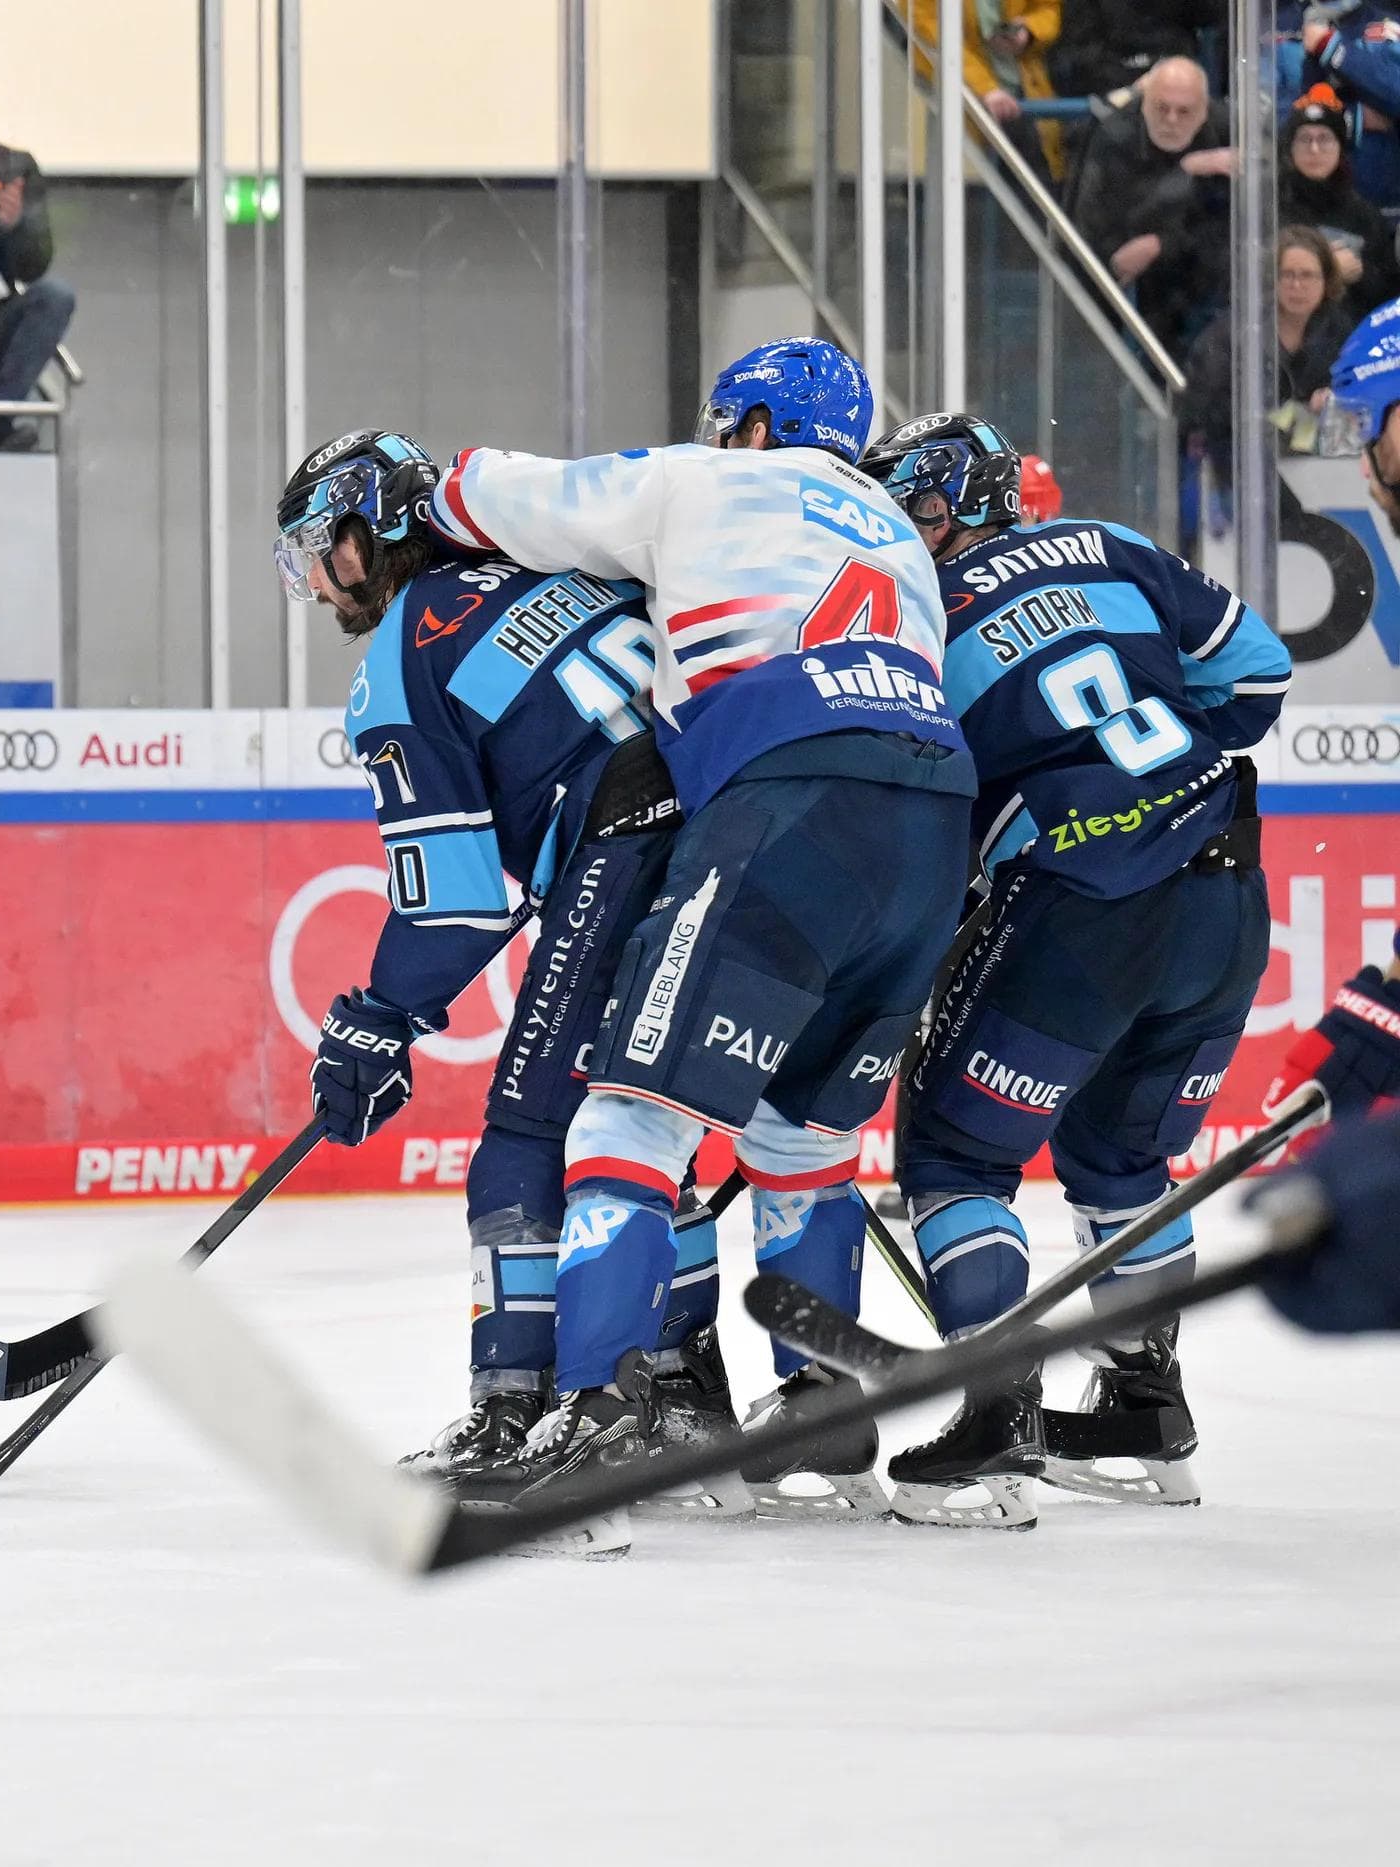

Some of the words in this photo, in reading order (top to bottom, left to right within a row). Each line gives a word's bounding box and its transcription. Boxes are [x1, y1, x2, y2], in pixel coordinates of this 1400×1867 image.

[845, 404, 859, 422] 4
[801, 489, 895, 543] SAP
[962, 529, 1108, 594] SATURN
[802, 650, 945, 713] inter
[1038, 642, 1193, 778] 9
[80, 733, 184, 769] Audi
[646, 921, 696, 1021] LIEBLANG
[965, 1049, 1068, 1109] CINQUE
[557, 1203, 629, 1267] AP
[752, 1189, 817, 1250] AP
